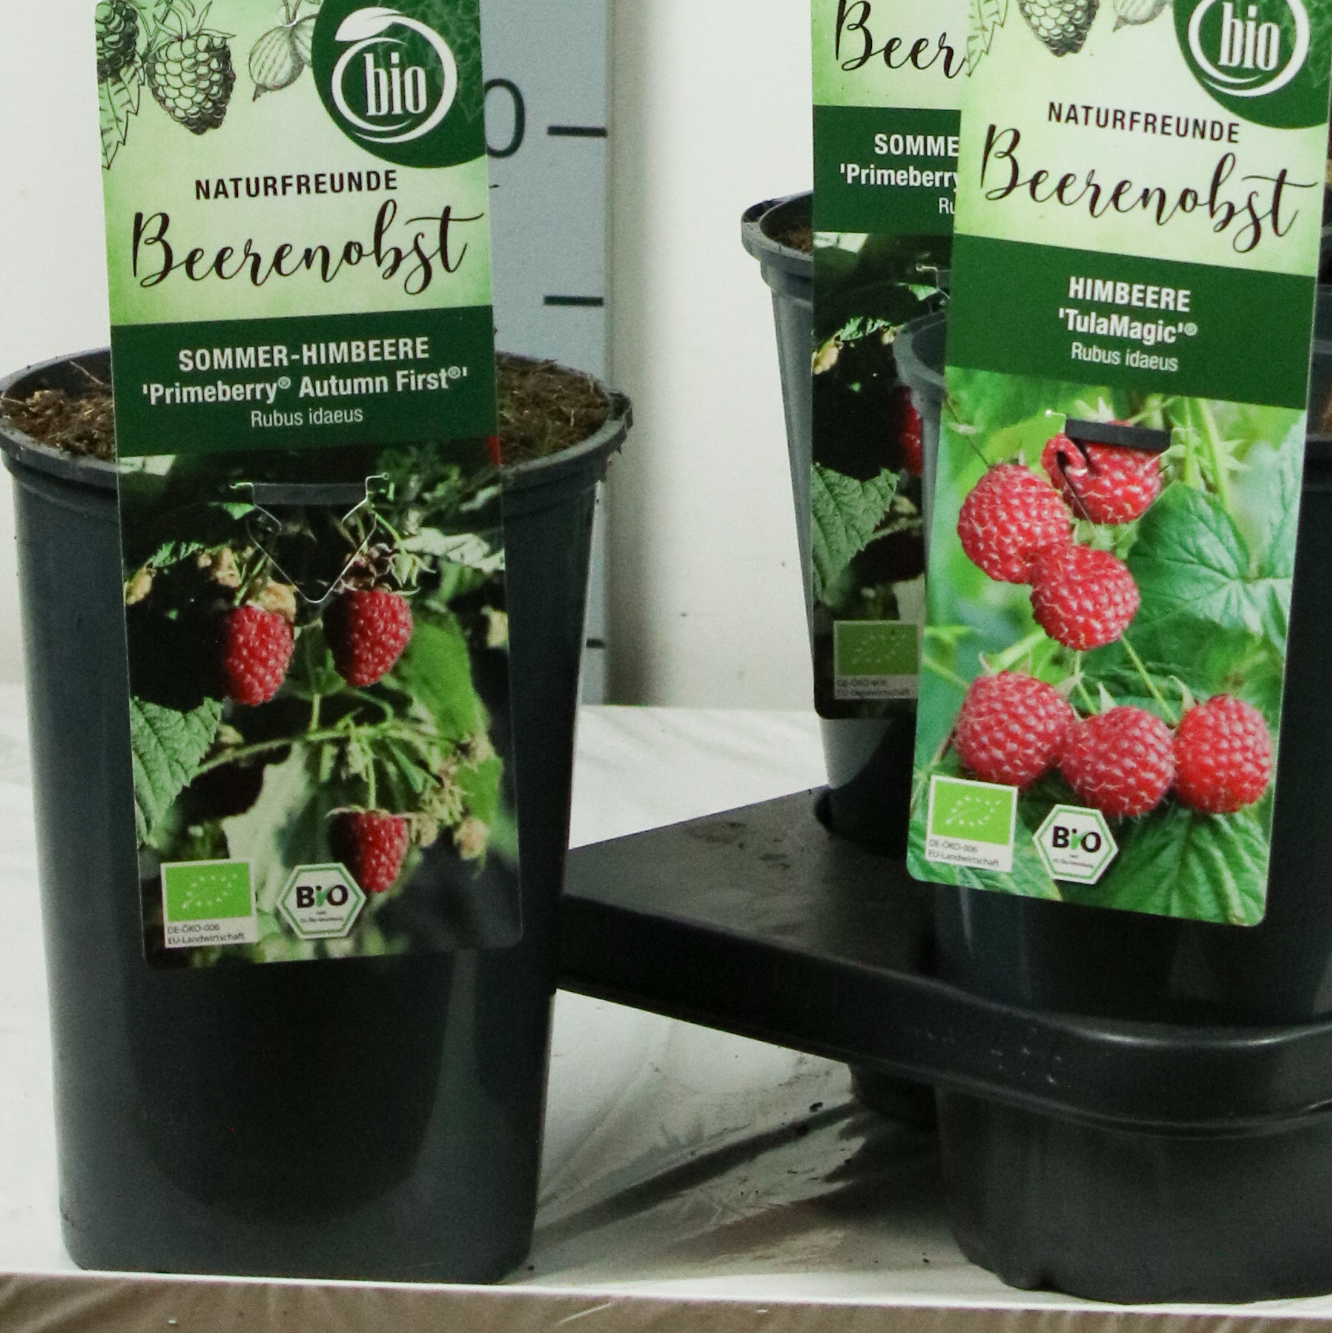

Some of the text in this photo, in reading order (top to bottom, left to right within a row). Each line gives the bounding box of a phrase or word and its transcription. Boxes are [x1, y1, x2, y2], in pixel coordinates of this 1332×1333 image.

[1217, 0, 1281, 72] bio
[363, 52, 428, 117] bio
[1046, 101, 1241, 144] NATURFREUNDE
[195, 169, 398, 200] NATURFREUNDE
[979, 123, 1319, 255] Beerenobst
[132, 199, 485, 295] Beerenobst
[1068, 276, 1192, 312] HIMBEERE
[178, 336, 430, 371] SOMMER-HIMBEERE
[1071, 341, 1179, 372] Rubus idaeus
[299, 374, 389, 398] Autumn
[250, 407, 364, 427] Rubus idaeus
